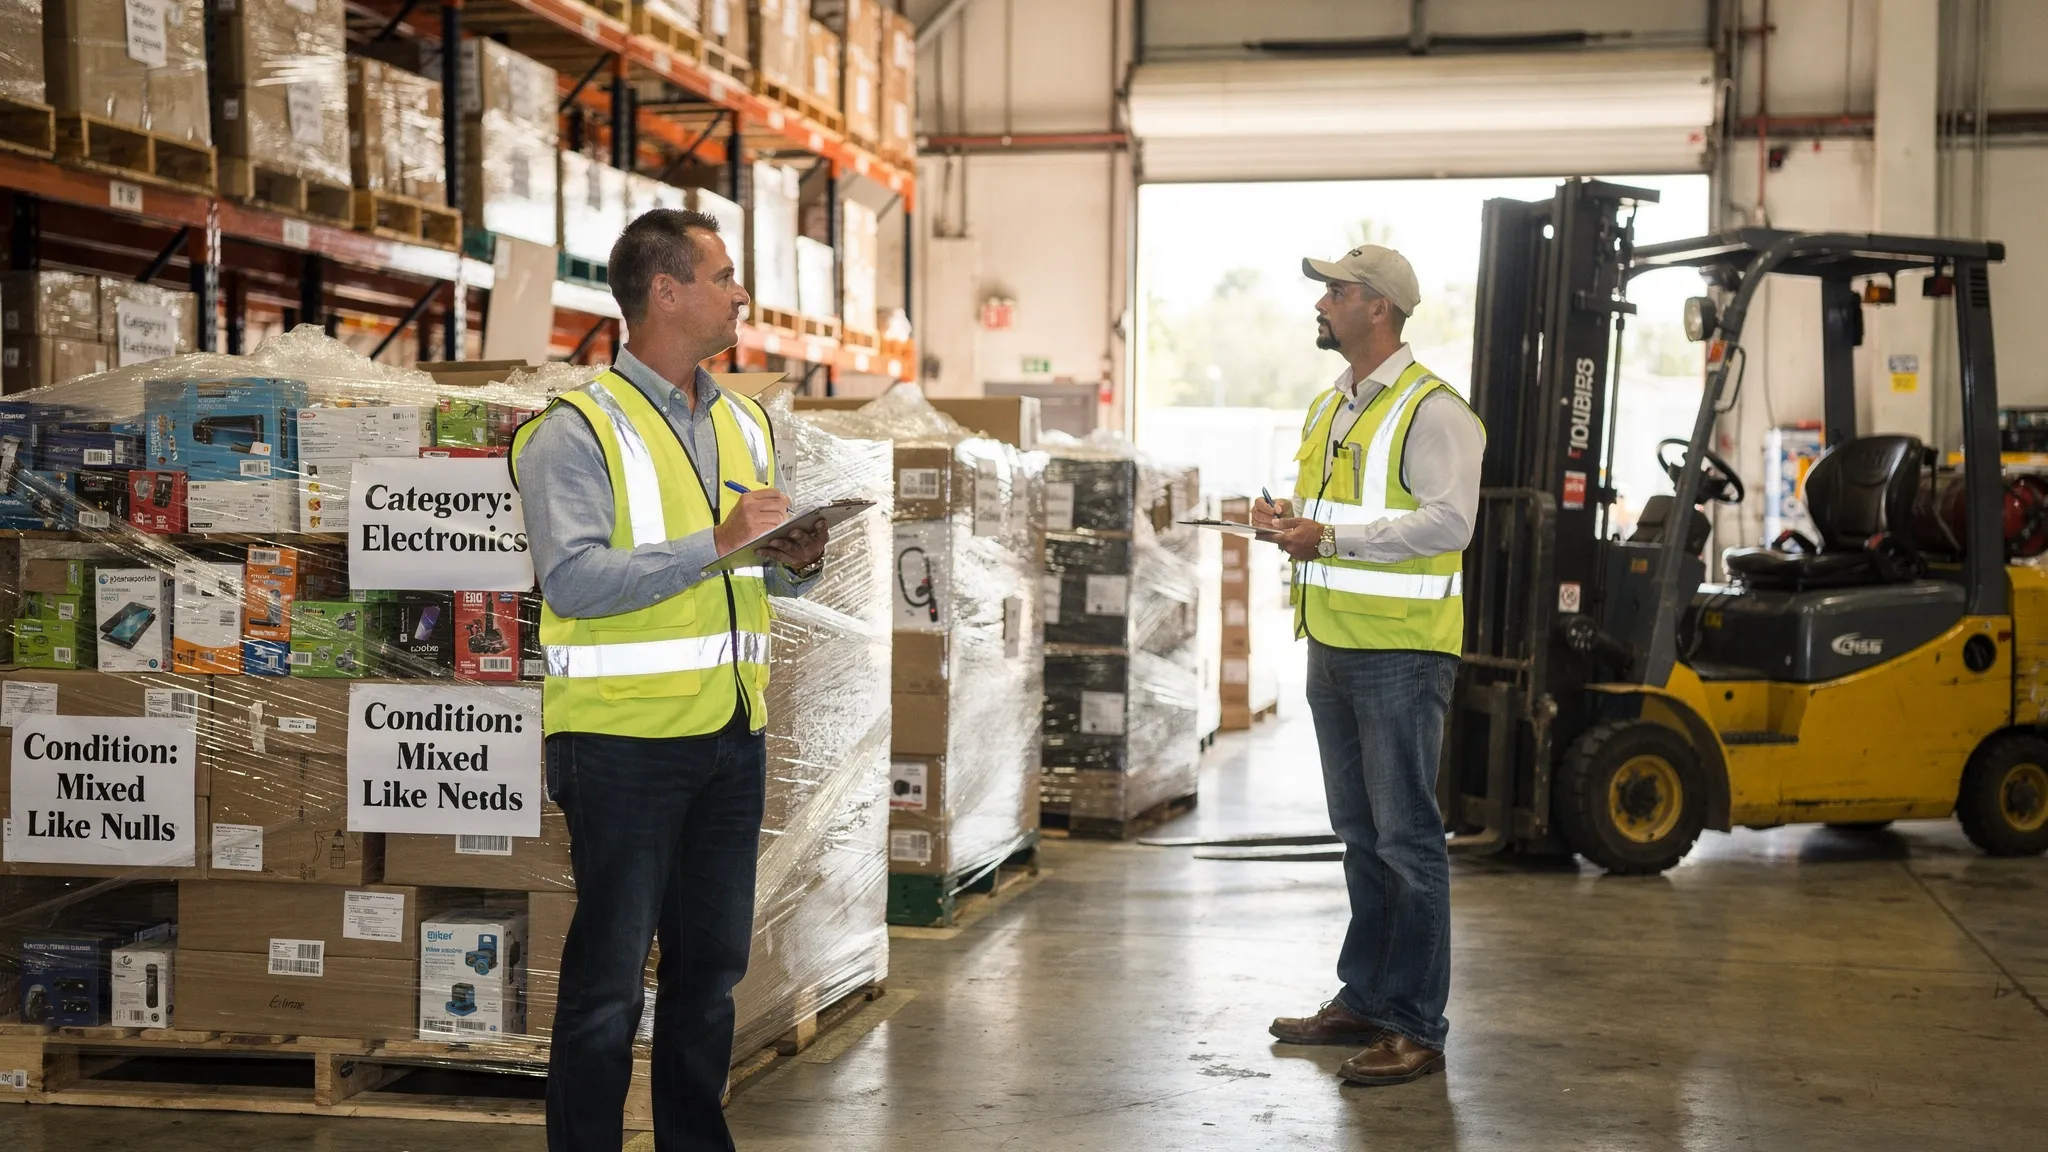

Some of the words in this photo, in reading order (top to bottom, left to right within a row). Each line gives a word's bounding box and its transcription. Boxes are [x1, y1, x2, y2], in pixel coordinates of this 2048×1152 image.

[364, 483, 513, 519] Category:
[362, 524, 528, 553] Electronics
[364, 701, 523, 734] Condition:
[23, 732, 178, 765] Condition:
[396, 741, 489, 772] Mixed
[56, 772, 146, 802] Mixed
[362, 779, 428, 809] Like
[27, 810, 91, 839] Like
[100, 812, 176, 842] Nulls
